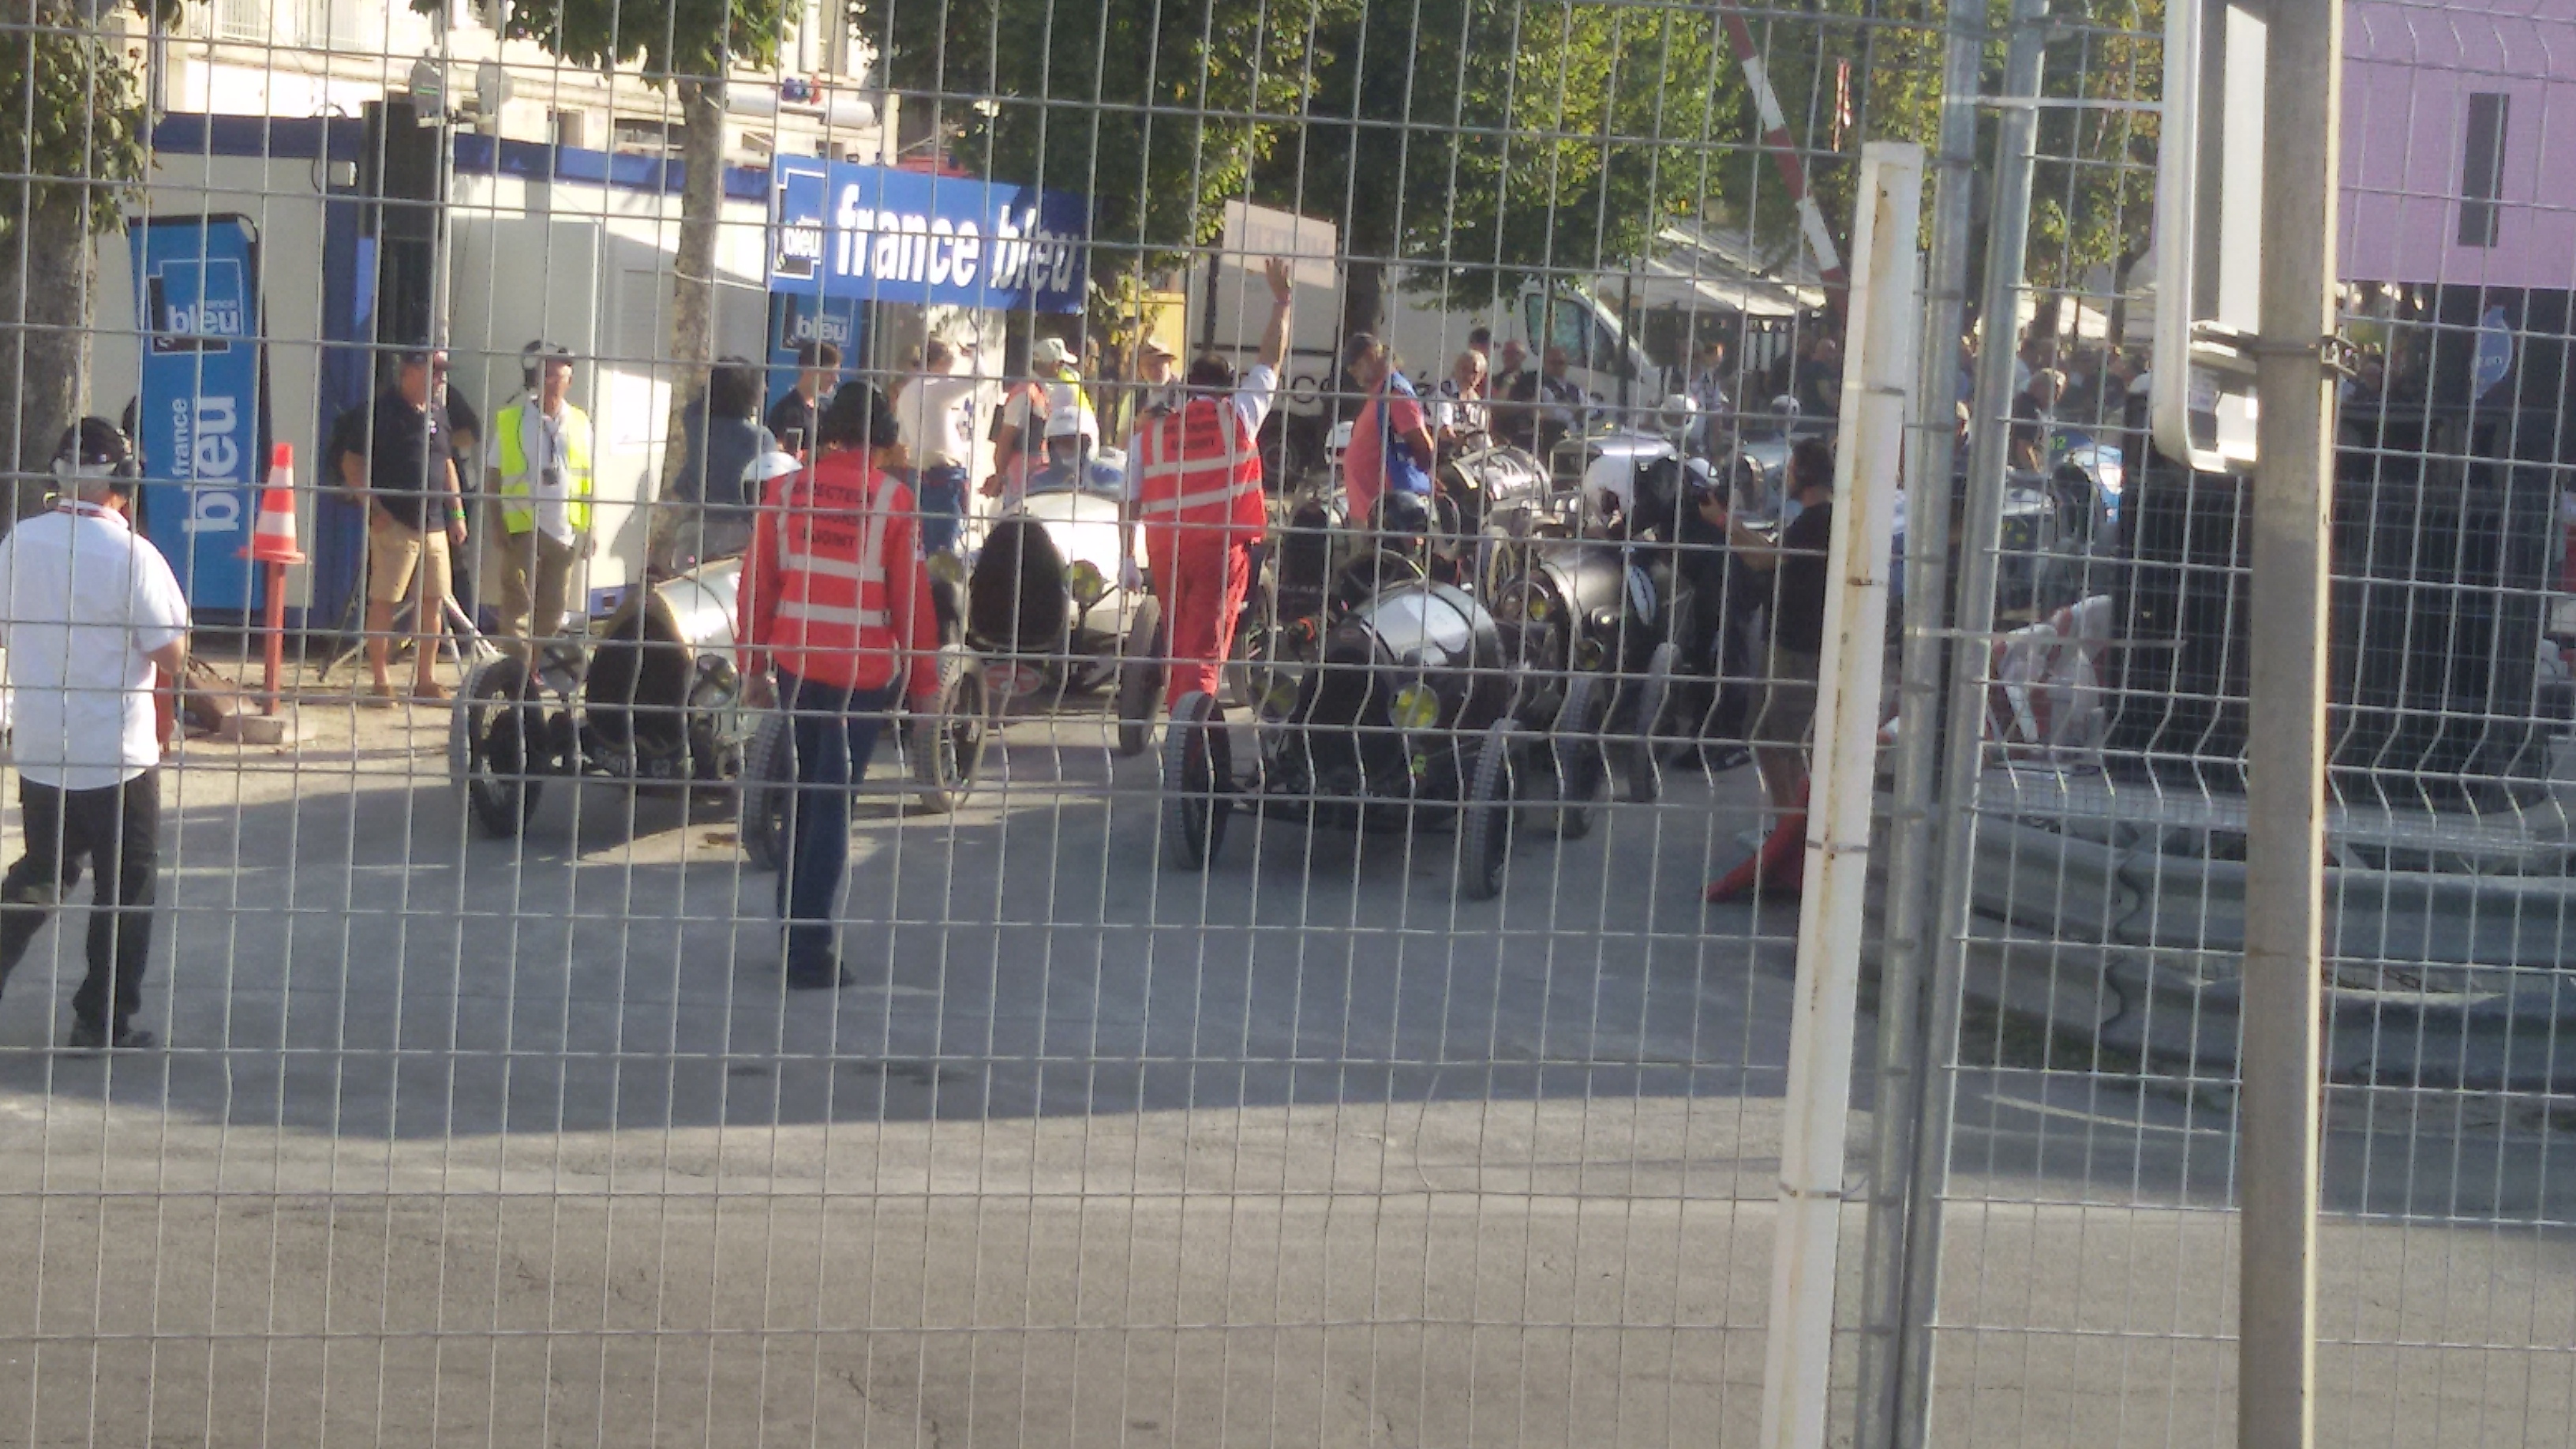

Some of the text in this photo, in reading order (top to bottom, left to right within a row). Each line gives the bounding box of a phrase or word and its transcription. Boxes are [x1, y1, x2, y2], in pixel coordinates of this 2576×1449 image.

[837, 184, 1078, 292] france bleu
[167, 304, 238, 335] bleu
[796, 315, 848, 341] bleu
[172, 397, 190, 476] france
[182, 396, 241, 531] bleu
[792, 481, 874, 506] DIECTEU
